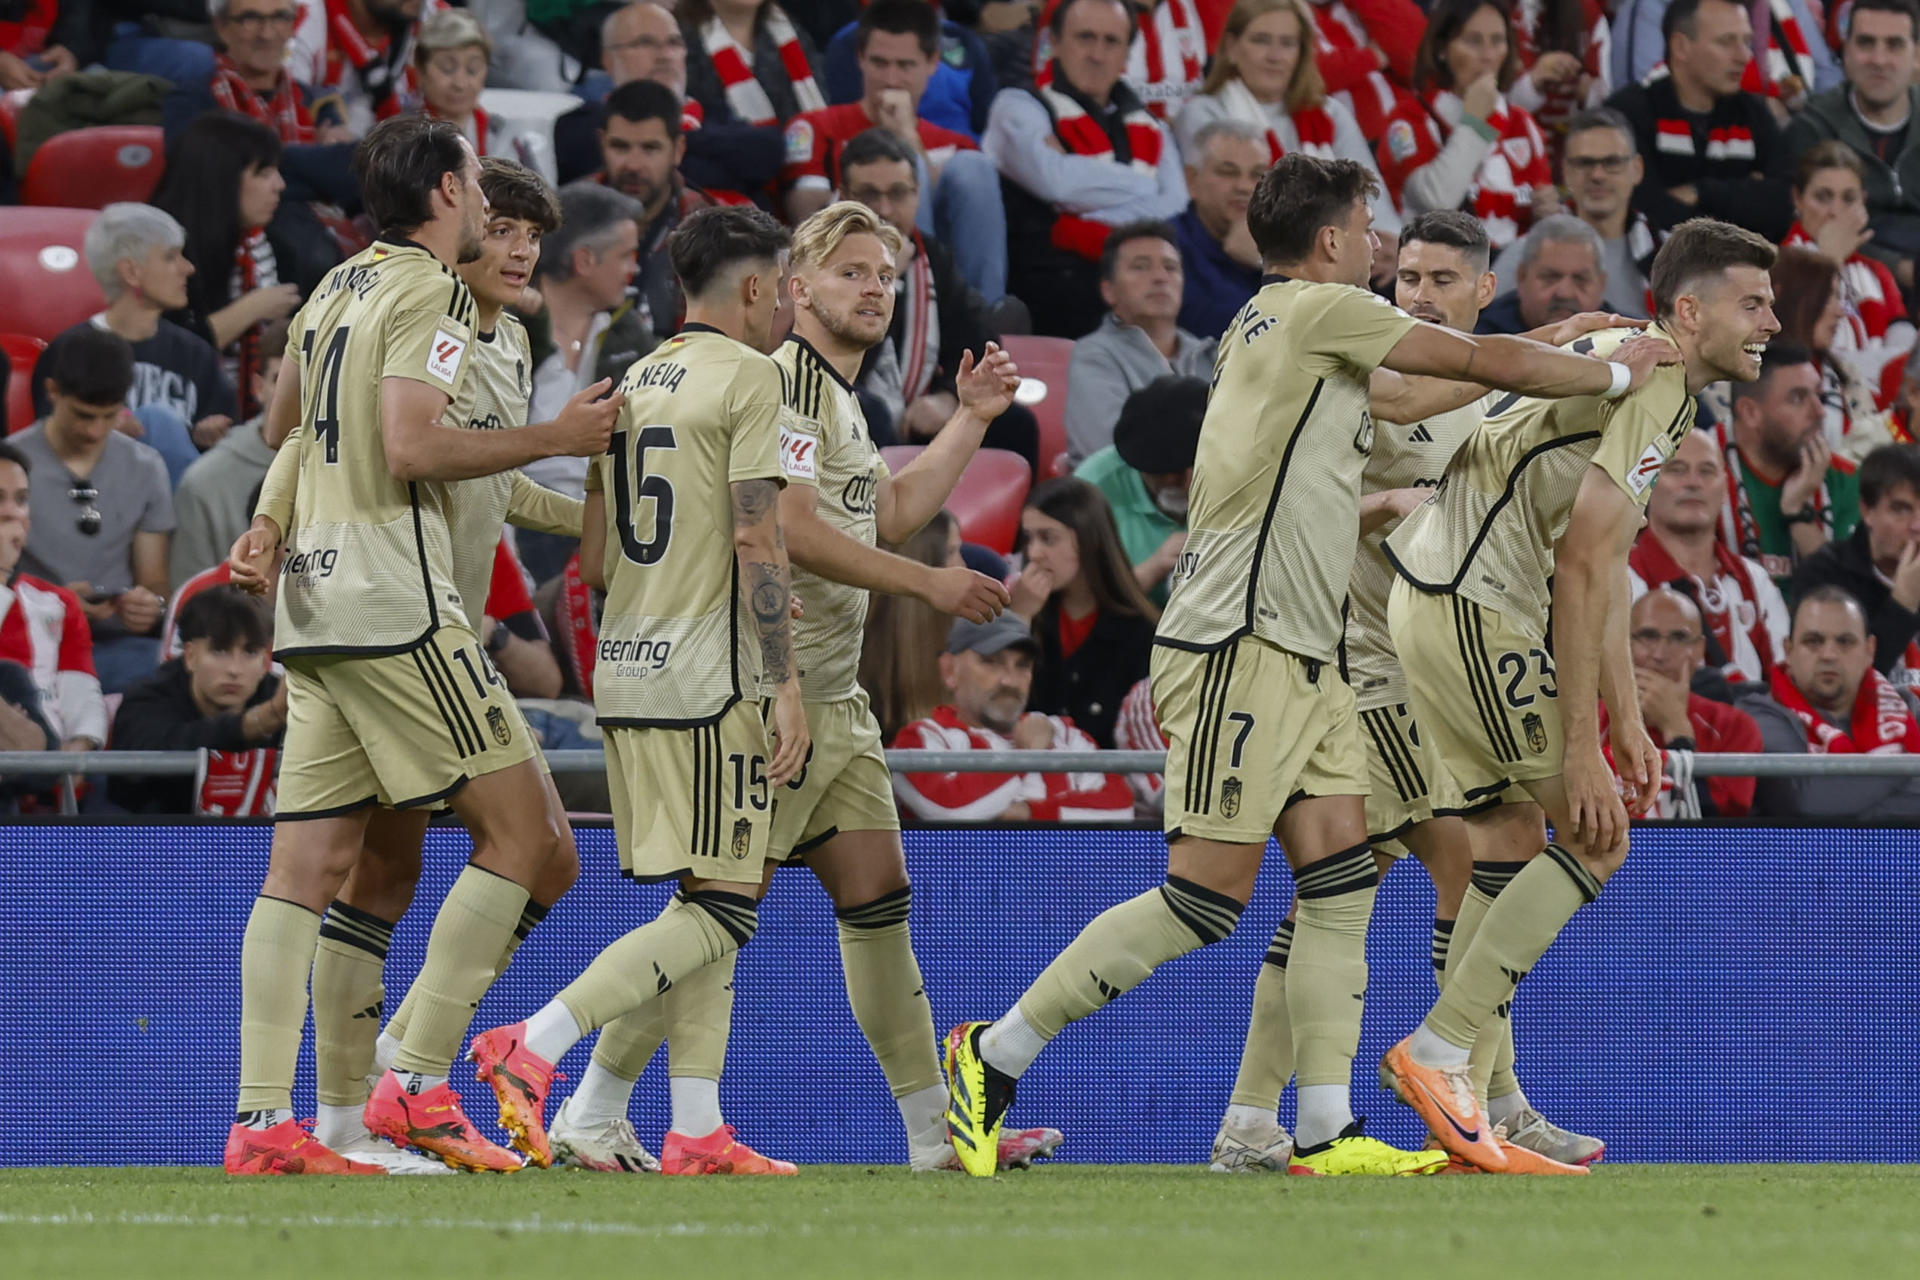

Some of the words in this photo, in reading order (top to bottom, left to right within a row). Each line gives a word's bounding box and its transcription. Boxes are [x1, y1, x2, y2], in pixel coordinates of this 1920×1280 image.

[300, 325, 351, 464] 14
[636, 362, 687, 394] NEVA
[606, 426, 678, 565] 15
[789, 463, 812, 473] LALIGA
[452, 643, 506, 699] 14
[616, 663, 648, 680] Group
[1497, 648, 1558, 708] 23
[1227, 711, 1255, 769] 7
[728, 753, 768, 811] 15
